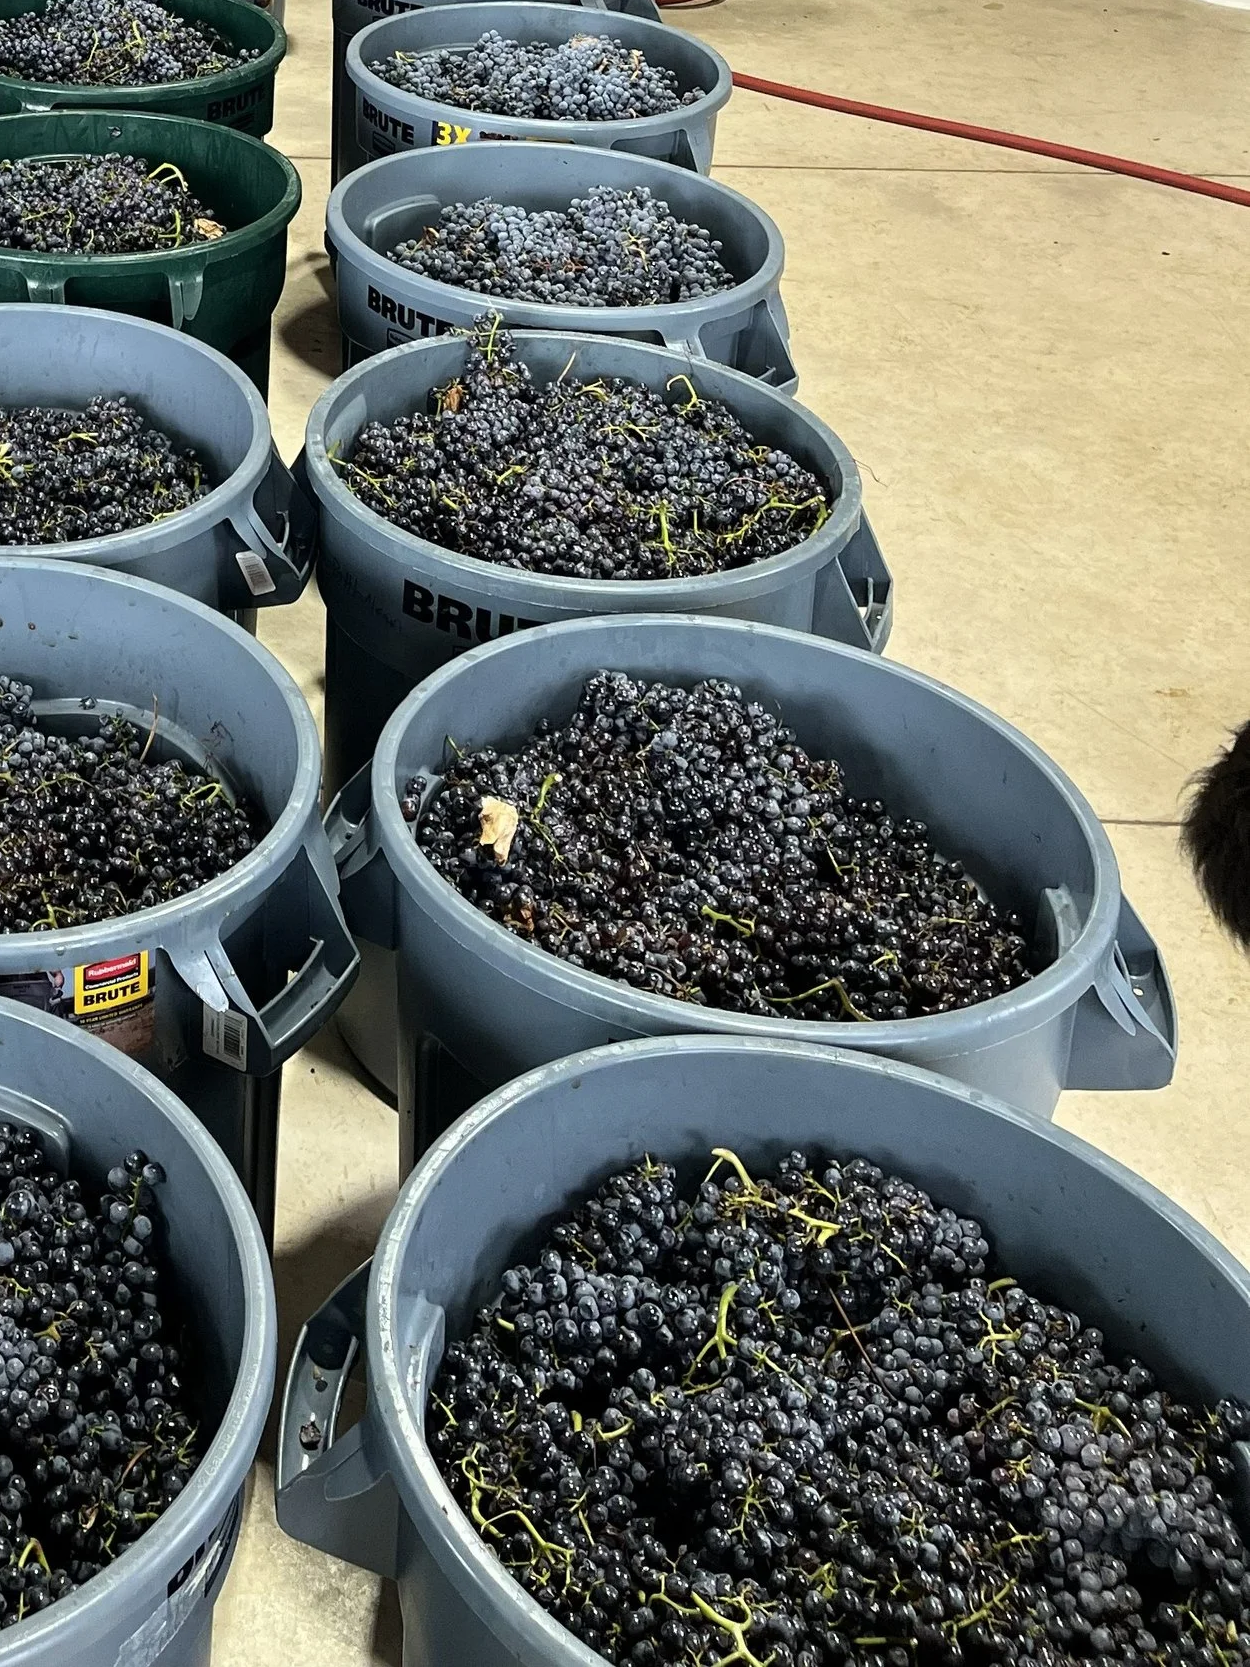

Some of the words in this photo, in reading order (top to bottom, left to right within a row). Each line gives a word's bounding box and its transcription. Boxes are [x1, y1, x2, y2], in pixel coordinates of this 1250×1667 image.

[362, 97, 415, 146] BRUTE
[435, 122, 473, 145] 3X
[402, 578, 551, 643] BRU
[87, 957, 137, 978] Rubbermaid
[84, 978, 117, 990] Commercial
[116, 972, 139, 984] Products
[83, 981, 141, 1007] BRUTE
